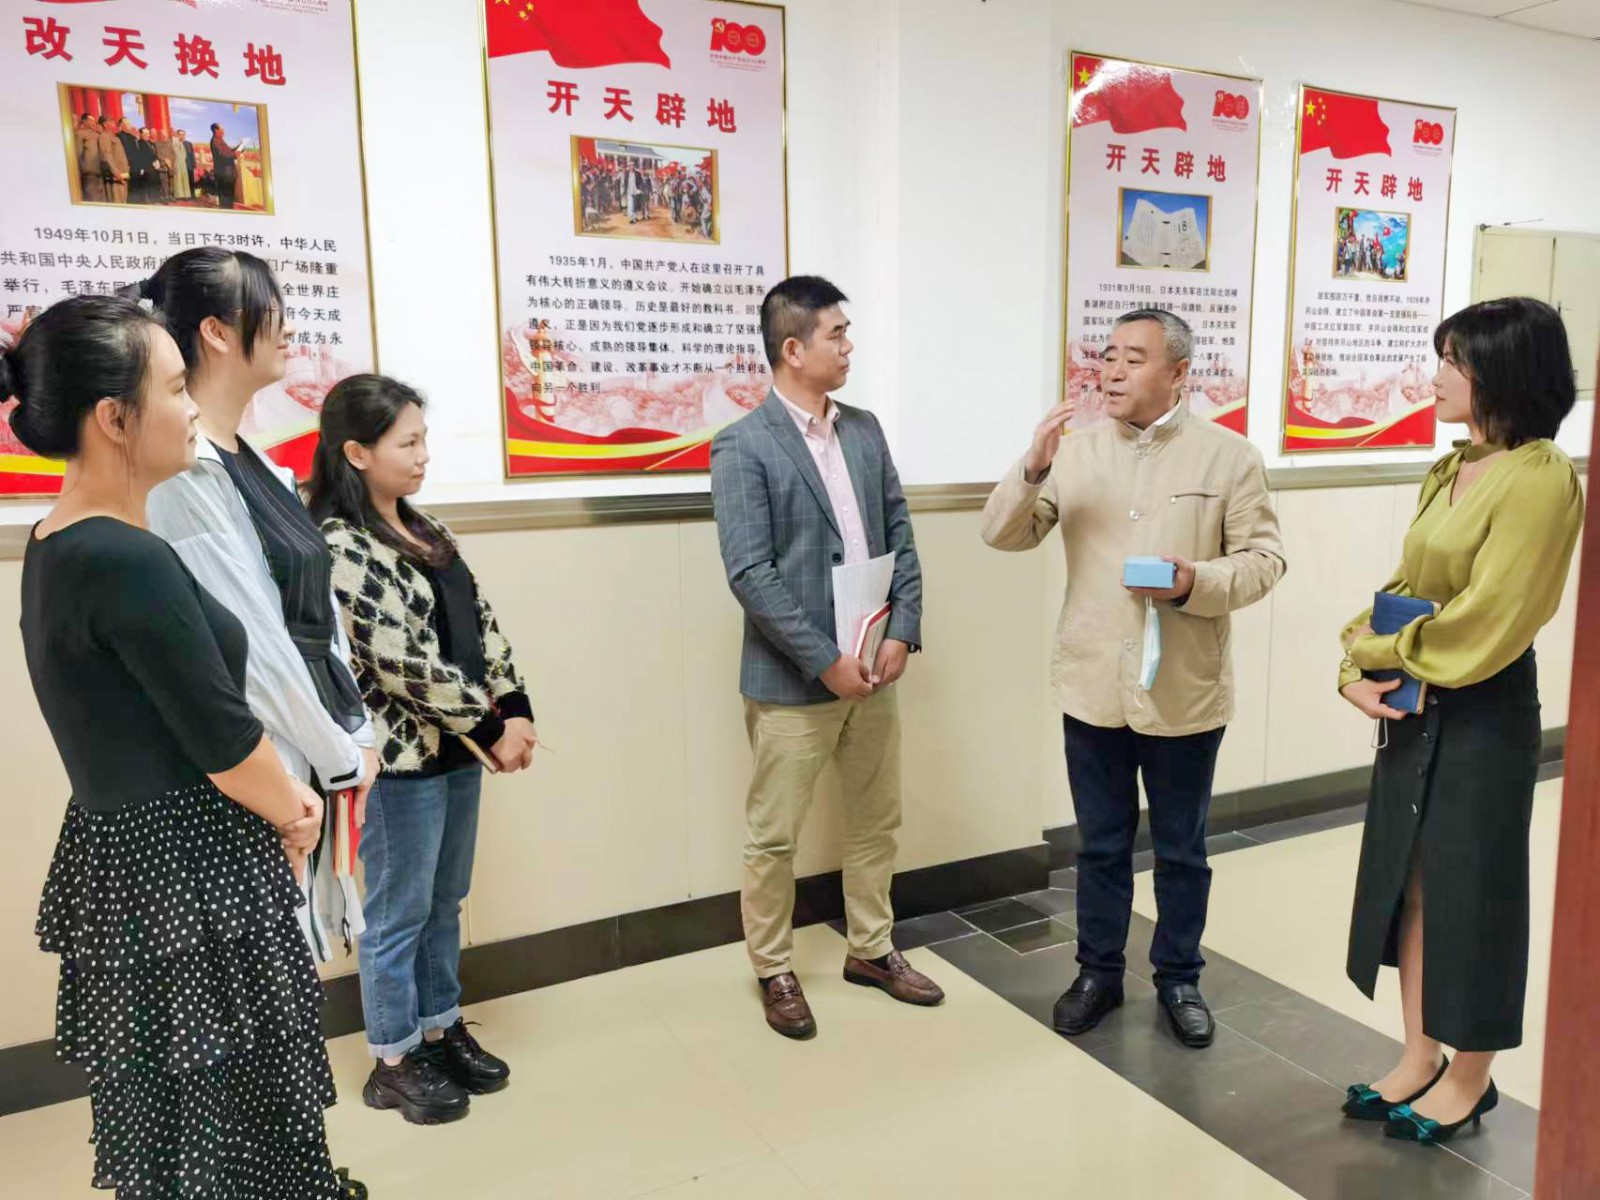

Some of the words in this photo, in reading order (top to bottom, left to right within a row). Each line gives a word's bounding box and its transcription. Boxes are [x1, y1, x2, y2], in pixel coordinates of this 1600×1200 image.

[23, 16, 286, 85] 改天换地
[547, 79, 736, 133] 开天辟地
[1106, 143, 1226, 182] 开天辟地
[1326, 168, 1424, 202] 开天辟地
[4, 278, 140, 296] 举行，毛泽东同
[282, 283, 340, 300] 全世界庄
